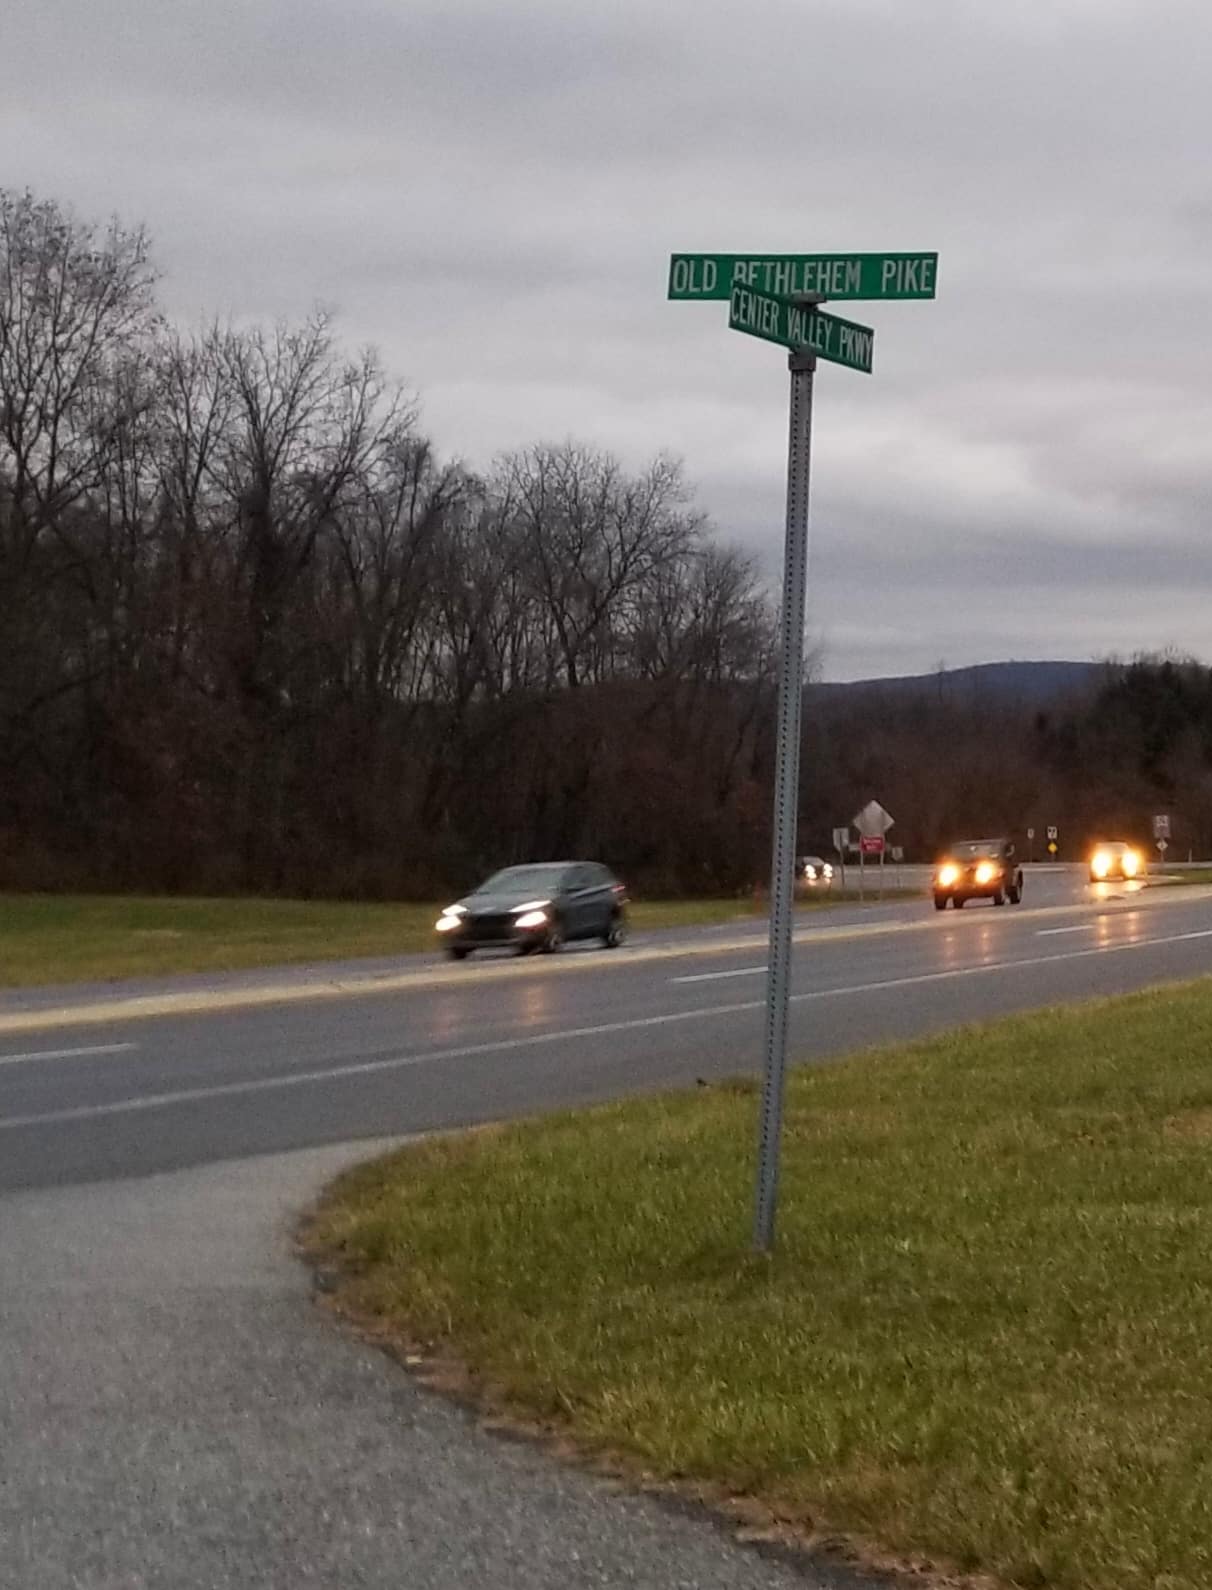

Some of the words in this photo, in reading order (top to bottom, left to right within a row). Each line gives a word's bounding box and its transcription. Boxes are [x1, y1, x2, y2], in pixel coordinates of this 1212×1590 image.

[672, 259, 717, 292] OLD
[732, 260, 861, 294] BETHLEHEM
[881, 259, 934, 293] PIKE
[731, 287, 779, 337] CENTER
[787, 305, 833, 351] VALLEY
[840, 325, 873, 368] PKWY
